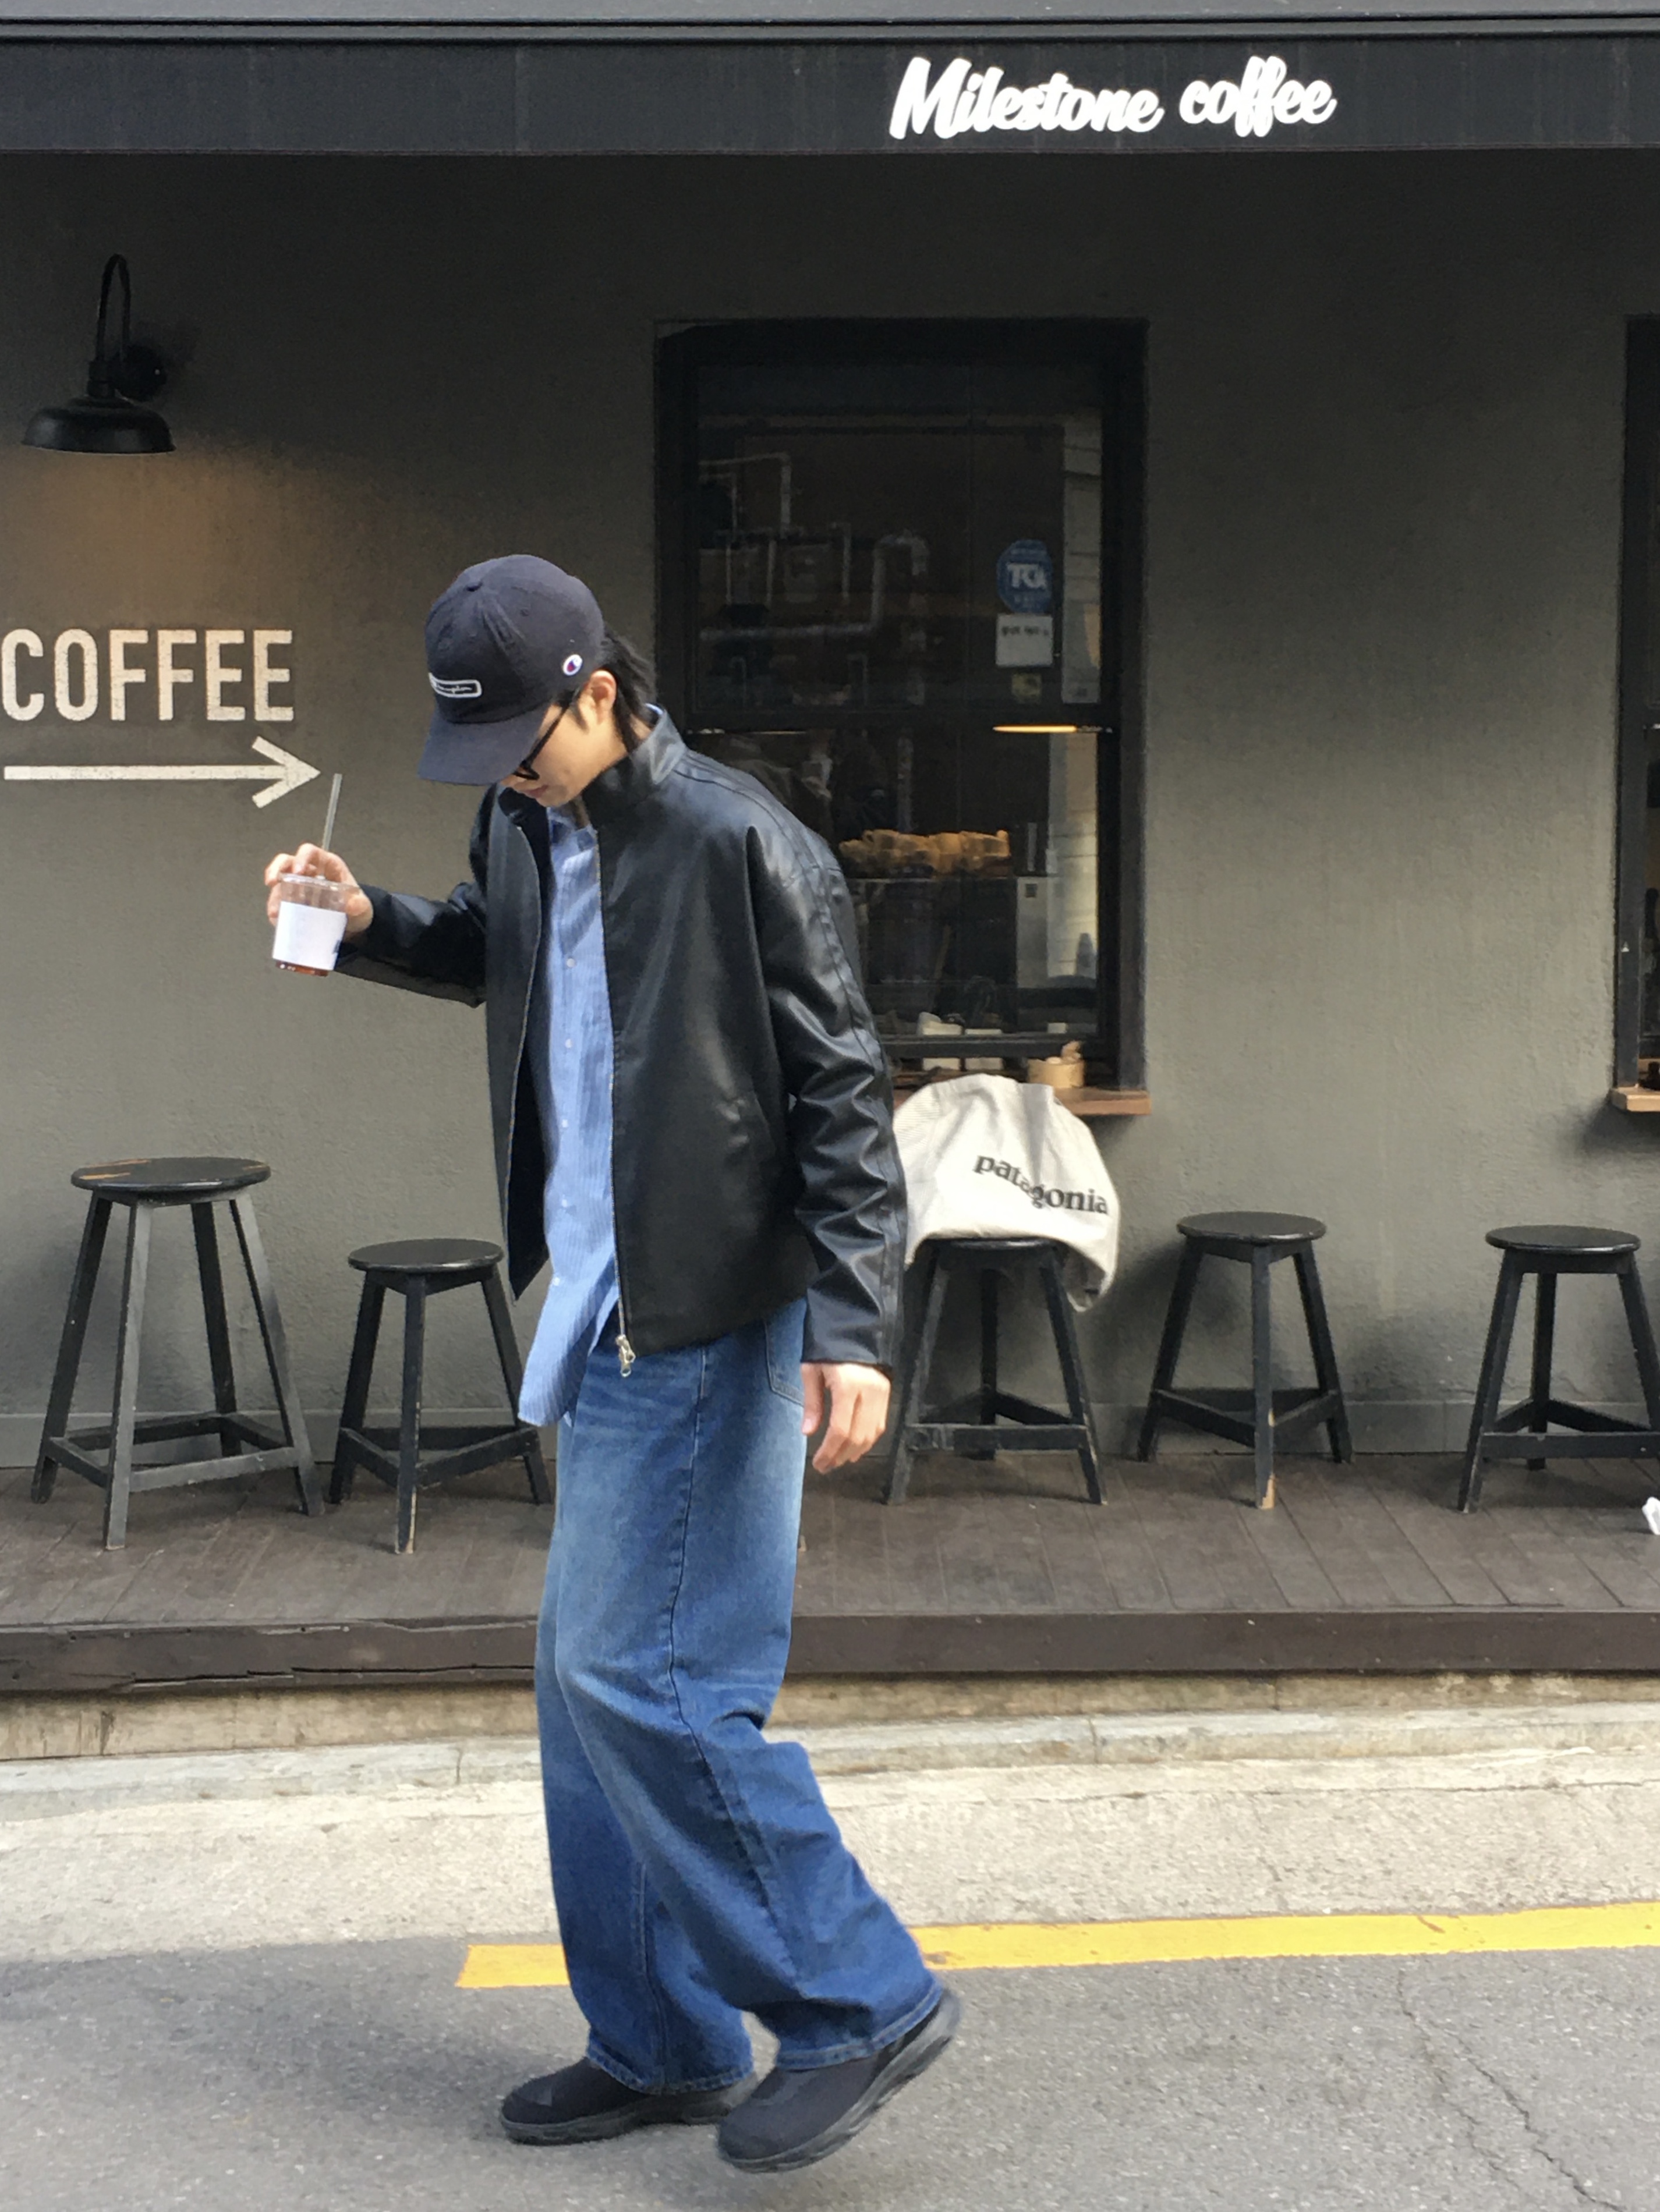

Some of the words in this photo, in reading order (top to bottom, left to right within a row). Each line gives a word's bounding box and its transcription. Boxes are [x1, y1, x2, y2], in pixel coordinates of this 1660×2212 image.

[889, 56, 1165, 140] Milestone
[1178, 55, 1338, 137] coffee
[1, 628, 294, 721] COFFEE
[972, 1155, 1109, 1215] patagonia
